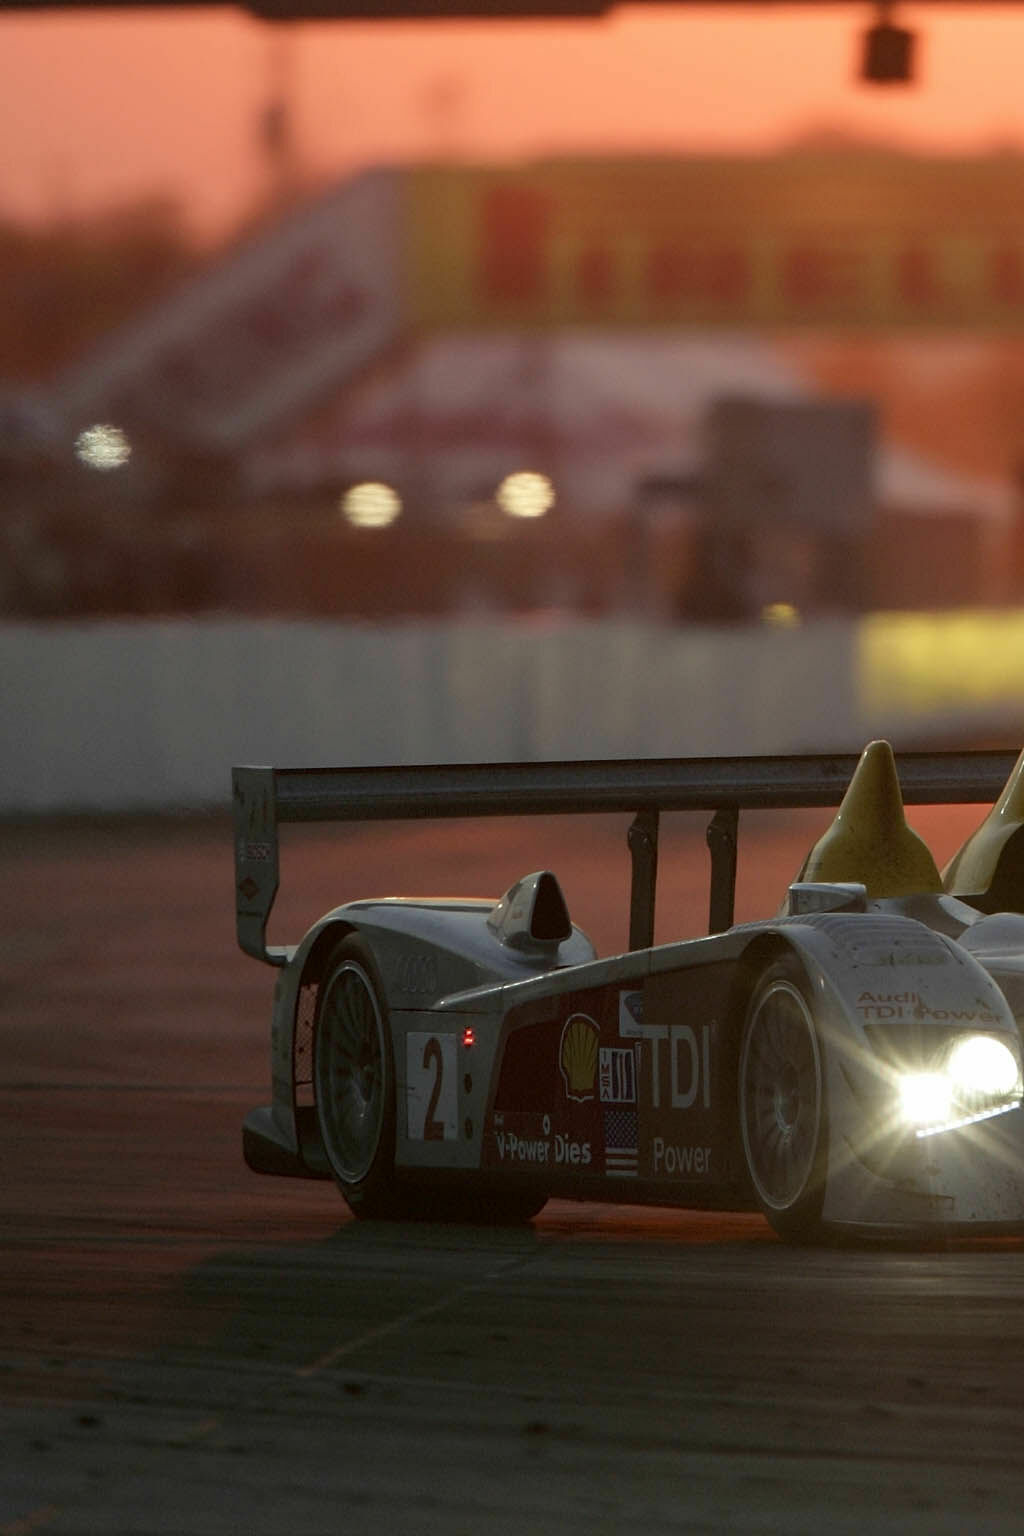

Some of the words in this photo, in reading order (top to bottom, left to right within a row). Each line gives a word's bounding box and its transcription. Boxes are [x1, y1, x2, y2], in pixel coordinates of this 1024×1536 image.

[855, 1005, 905, 1019] TDI
[914, 1007, 1004, 1024] Power
[857, 990, 917, 1004] Audi
[640, 1024, 714, 1110] TDI
[422, 1036, 445, 1141] 2
[495, 1133, 550, 1163] V-Power
[554, 1133, 592, 1166] Dies
[651, 1136, 713, 1175] Power
